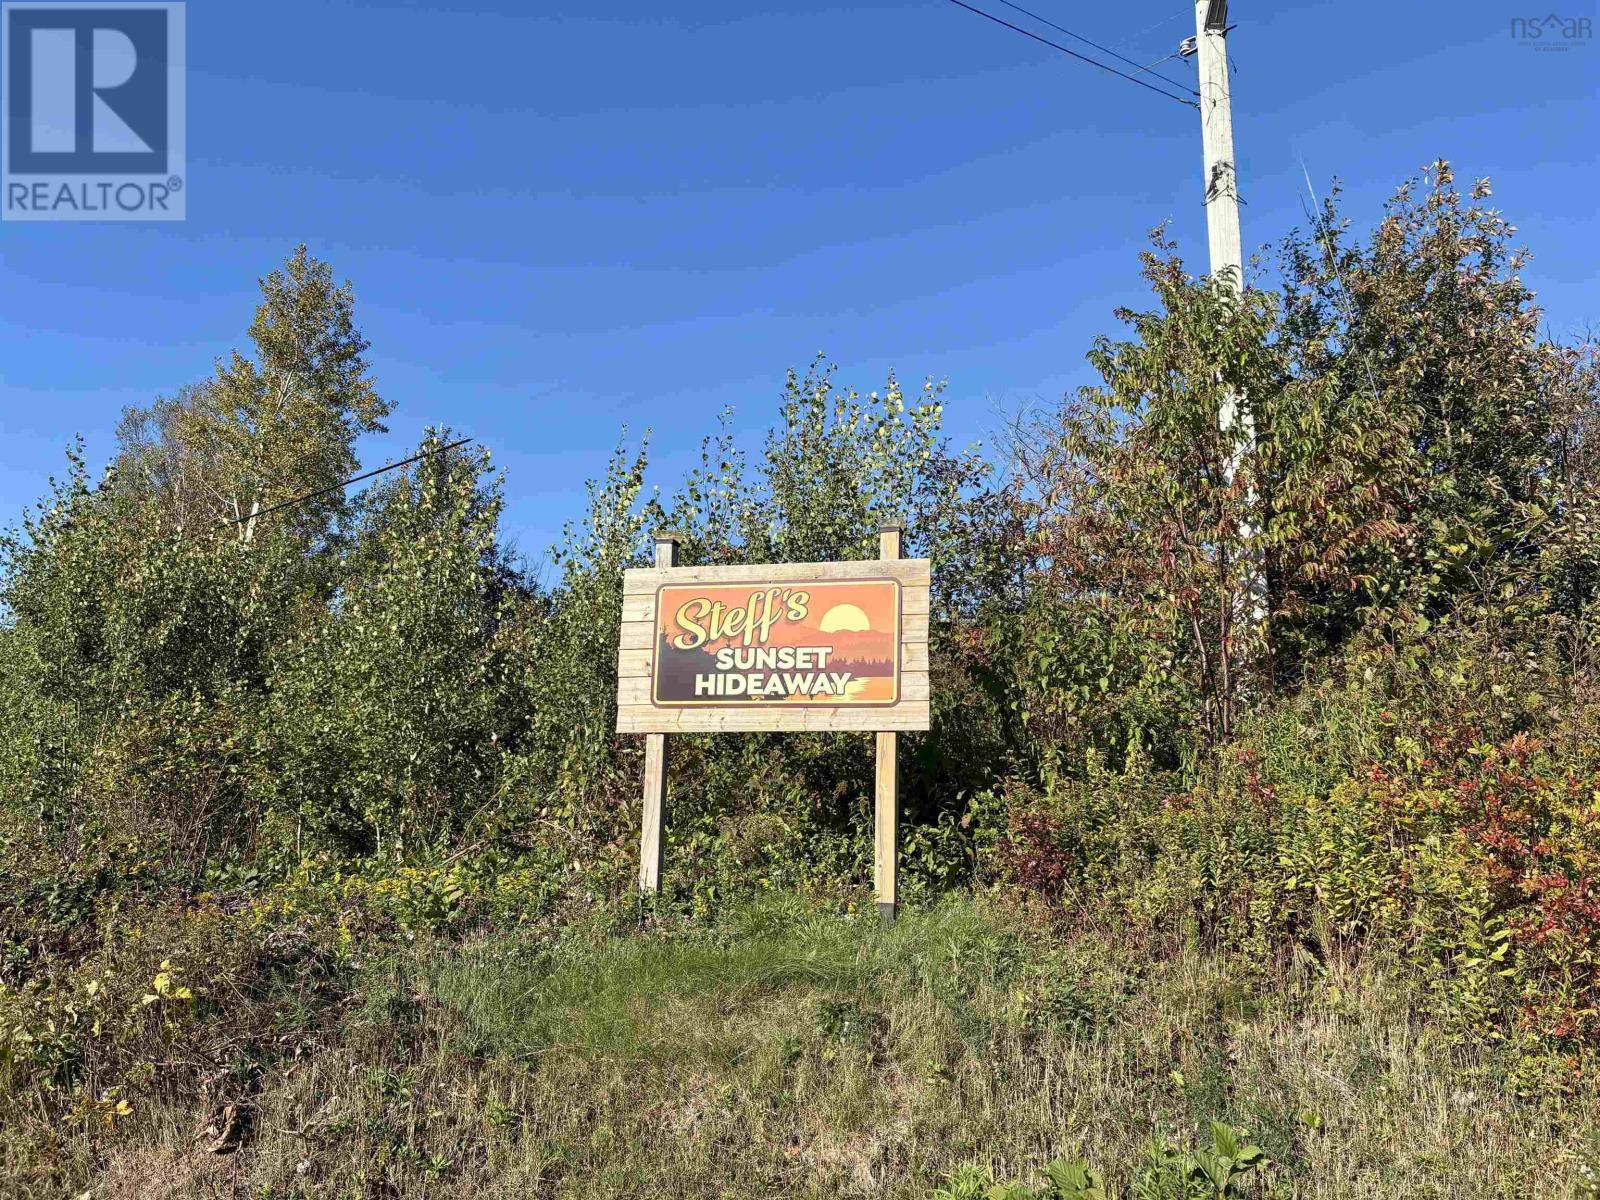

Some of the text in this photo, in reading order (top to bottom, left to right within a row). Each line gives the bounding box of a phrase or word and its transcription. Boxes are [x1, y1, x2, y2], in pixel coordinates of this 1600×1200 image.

[673, 587, 811, 650] Steff's
[715, 646, 833, 671] SUNSET
[694, 672, 852, 697] HIDEAWAY
